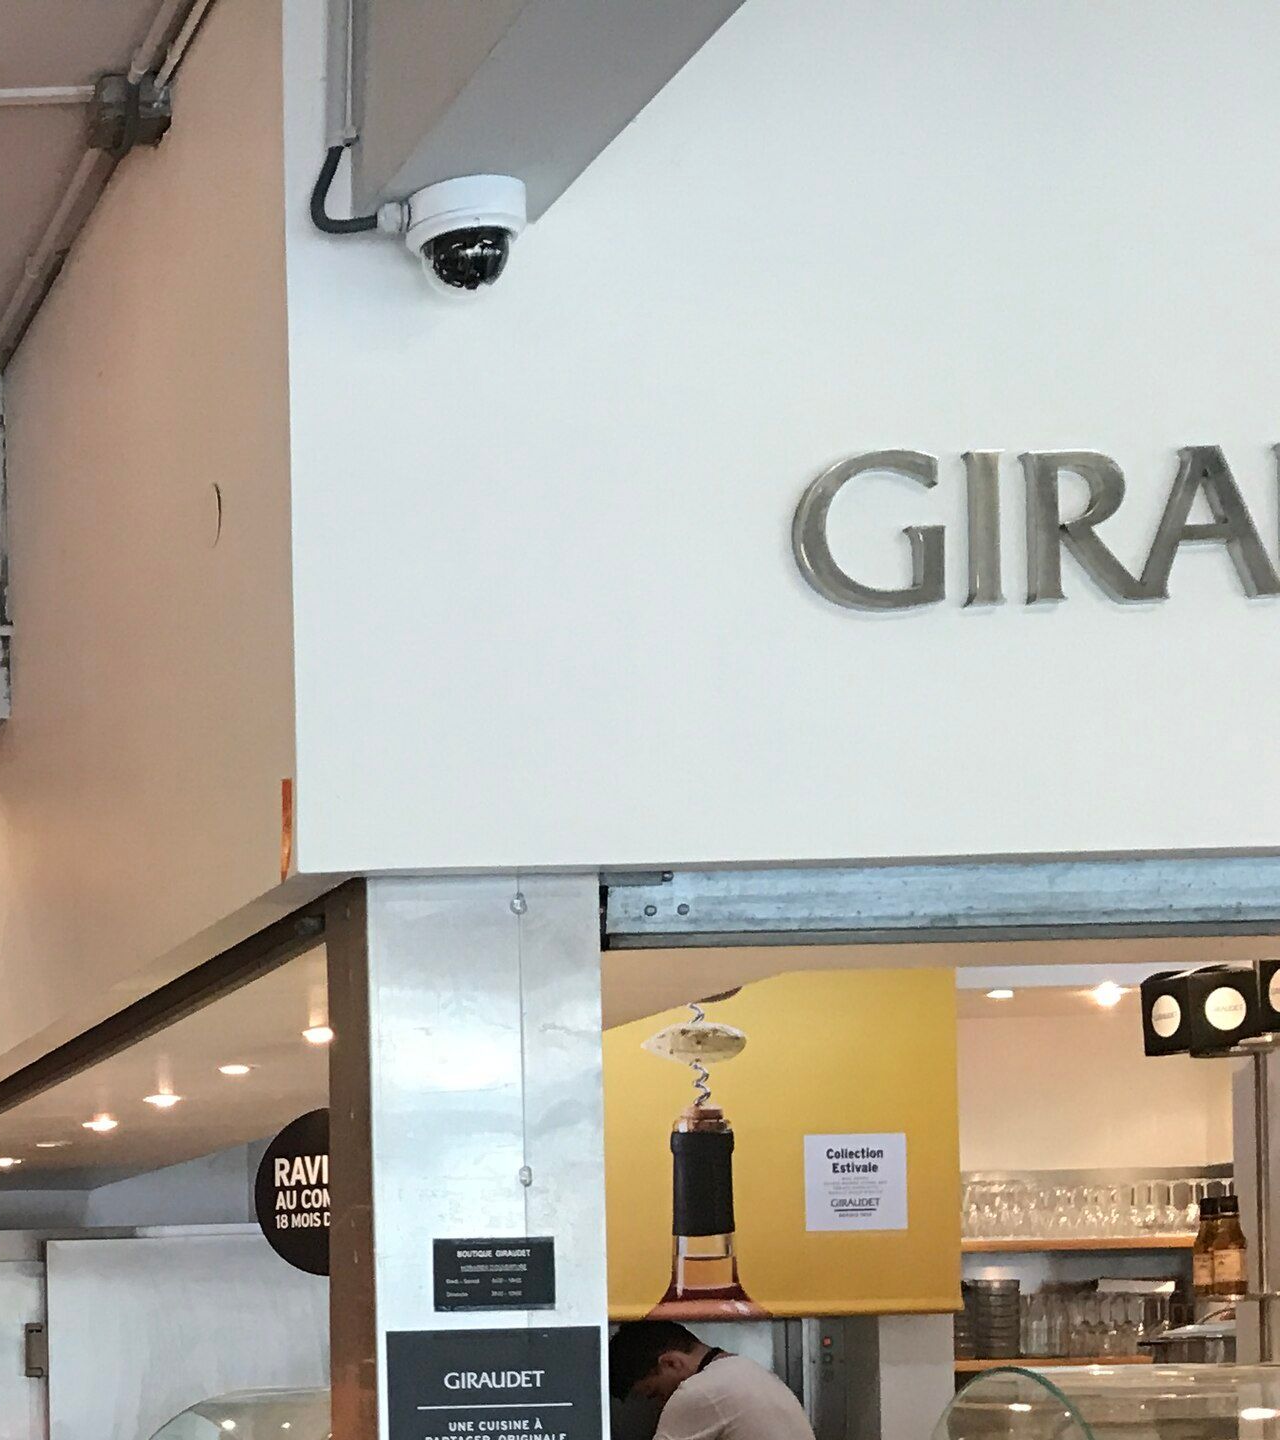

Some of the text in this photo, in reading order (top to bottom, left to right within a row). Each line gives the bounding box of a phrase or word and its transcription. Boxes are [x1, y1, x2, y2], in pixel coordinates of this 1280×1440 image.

[792, 442, 1280, 612] GIRA
[826, 1148, 884, 1159] Collection
[832, 1162, 879, 1173] Estivale
[275, 1190, 297, 1211] AU
[830, 1197, 881, 1208] GIRAUDET
[275, 1214, 289, 1229] 18
[291, 1212, 321, 1229] MOIS
[456, 1249, 531, 1258] BOUTIQUE GIRAUDET
[443, 1370, 546, 1390] GIRAUDET
[448, 1417, 543, 1432] UNE CUISINE À
